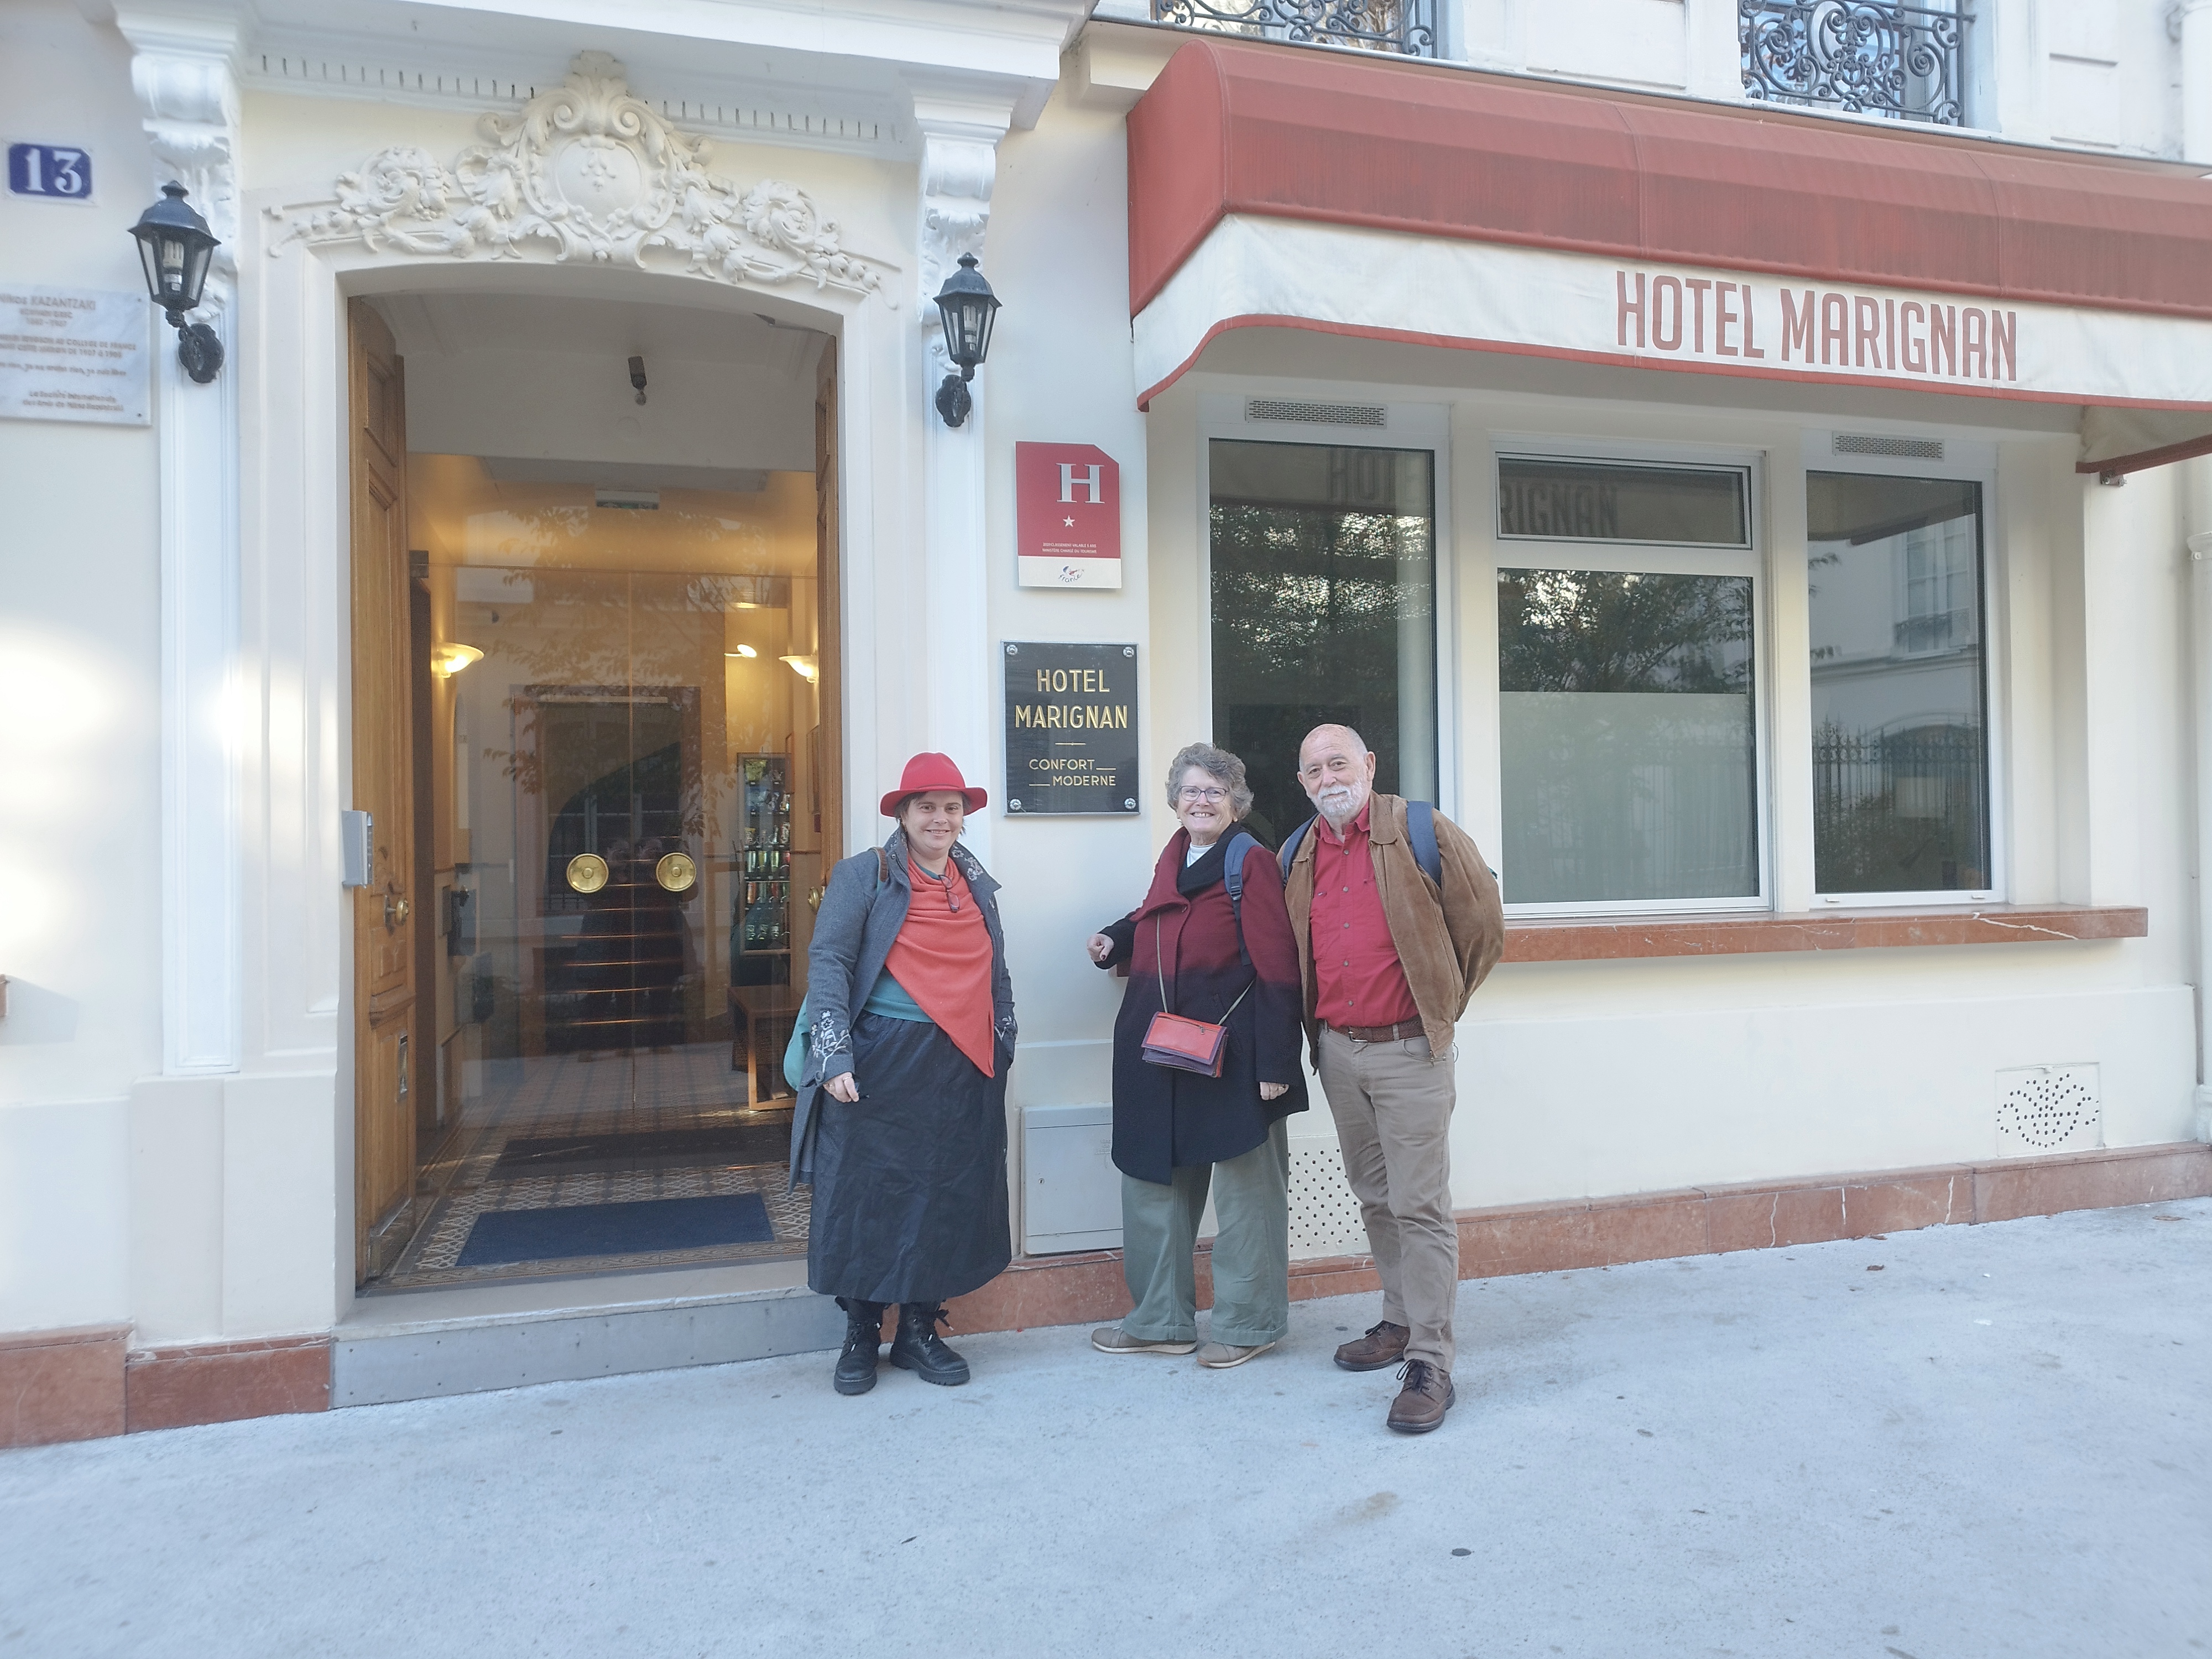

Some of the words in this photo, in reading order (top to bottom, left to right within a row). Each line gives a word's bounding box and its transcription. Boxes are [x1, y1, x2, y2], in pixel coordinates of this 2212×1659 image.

[25, 148, 82, 194] 13
[31, 295, 96, 310] KAZANTZAKI
[1616, 270, 1765, 358] HOTEL
[1780, 288, 2017, 382] MARIGNAN
[1056, 462, 1105, 504] H
[1037, 669, 1110, 692] HOTEL
[1015, 705, 1128, 729] MARIGNAN
[1029, 759, 1095, 770] CONFORT
[1052, 775, 1117, 786] MODERNE
